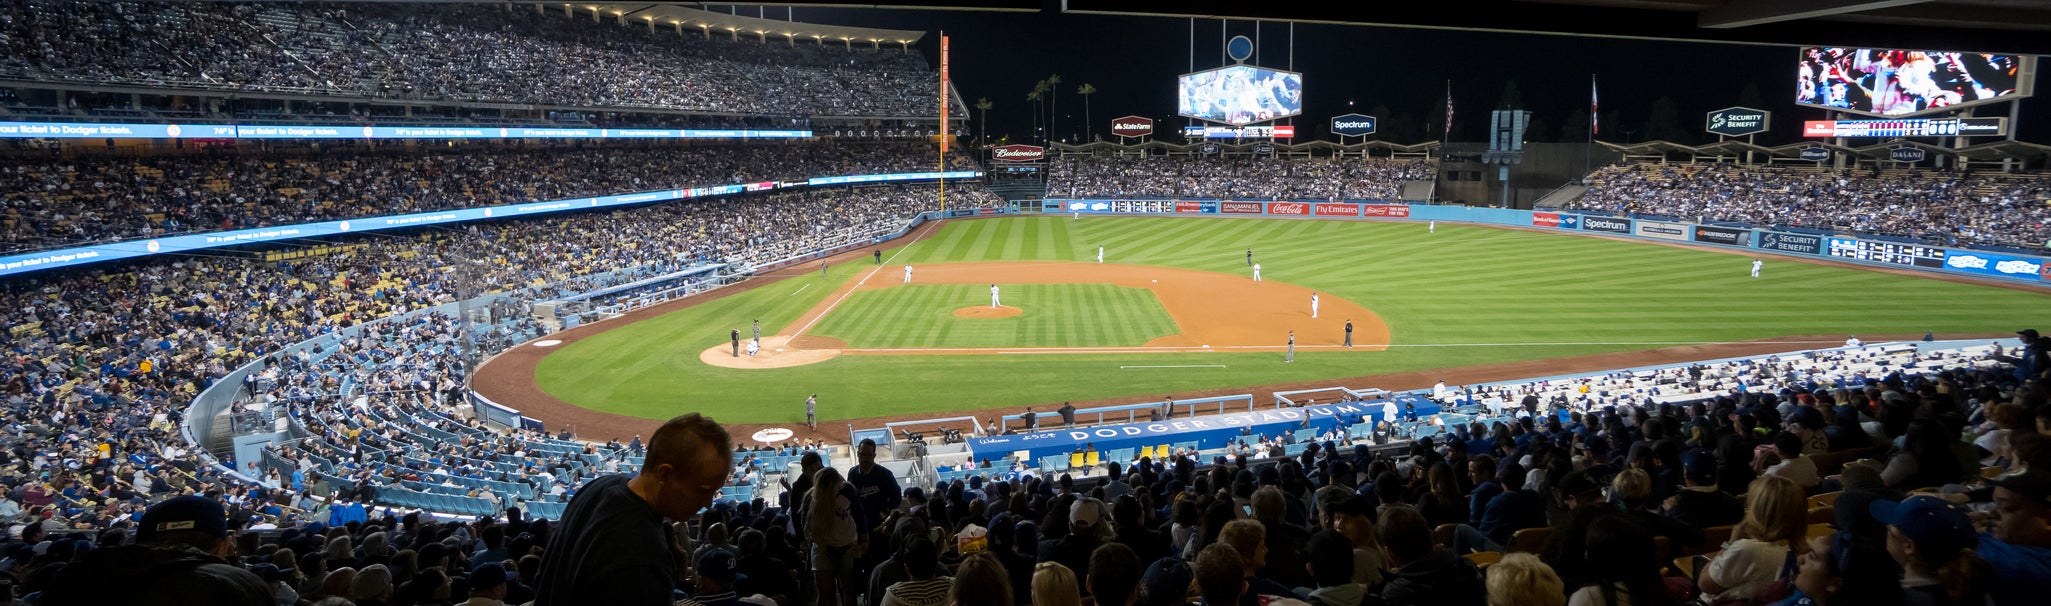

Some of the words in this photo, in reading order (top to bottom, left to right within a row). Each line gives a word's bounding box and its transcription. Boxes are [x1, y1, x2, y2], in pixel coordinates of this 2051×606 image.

[20, 125, 48, 134] ticket
[50, 126, 60, 134] to
[62, 126, 98, 136] Dodger
[1335, 121, 1369, 129] Spectrum
[994, 148, 1042, 158] Budweiser
[1585, 218, 1626, 231] Spectrum
[1779, 234, 1817, 245] SECURITY
[1778, 240, 1812, 252] BENEFIT
[1069, 420, 1210, 441] DODGER
